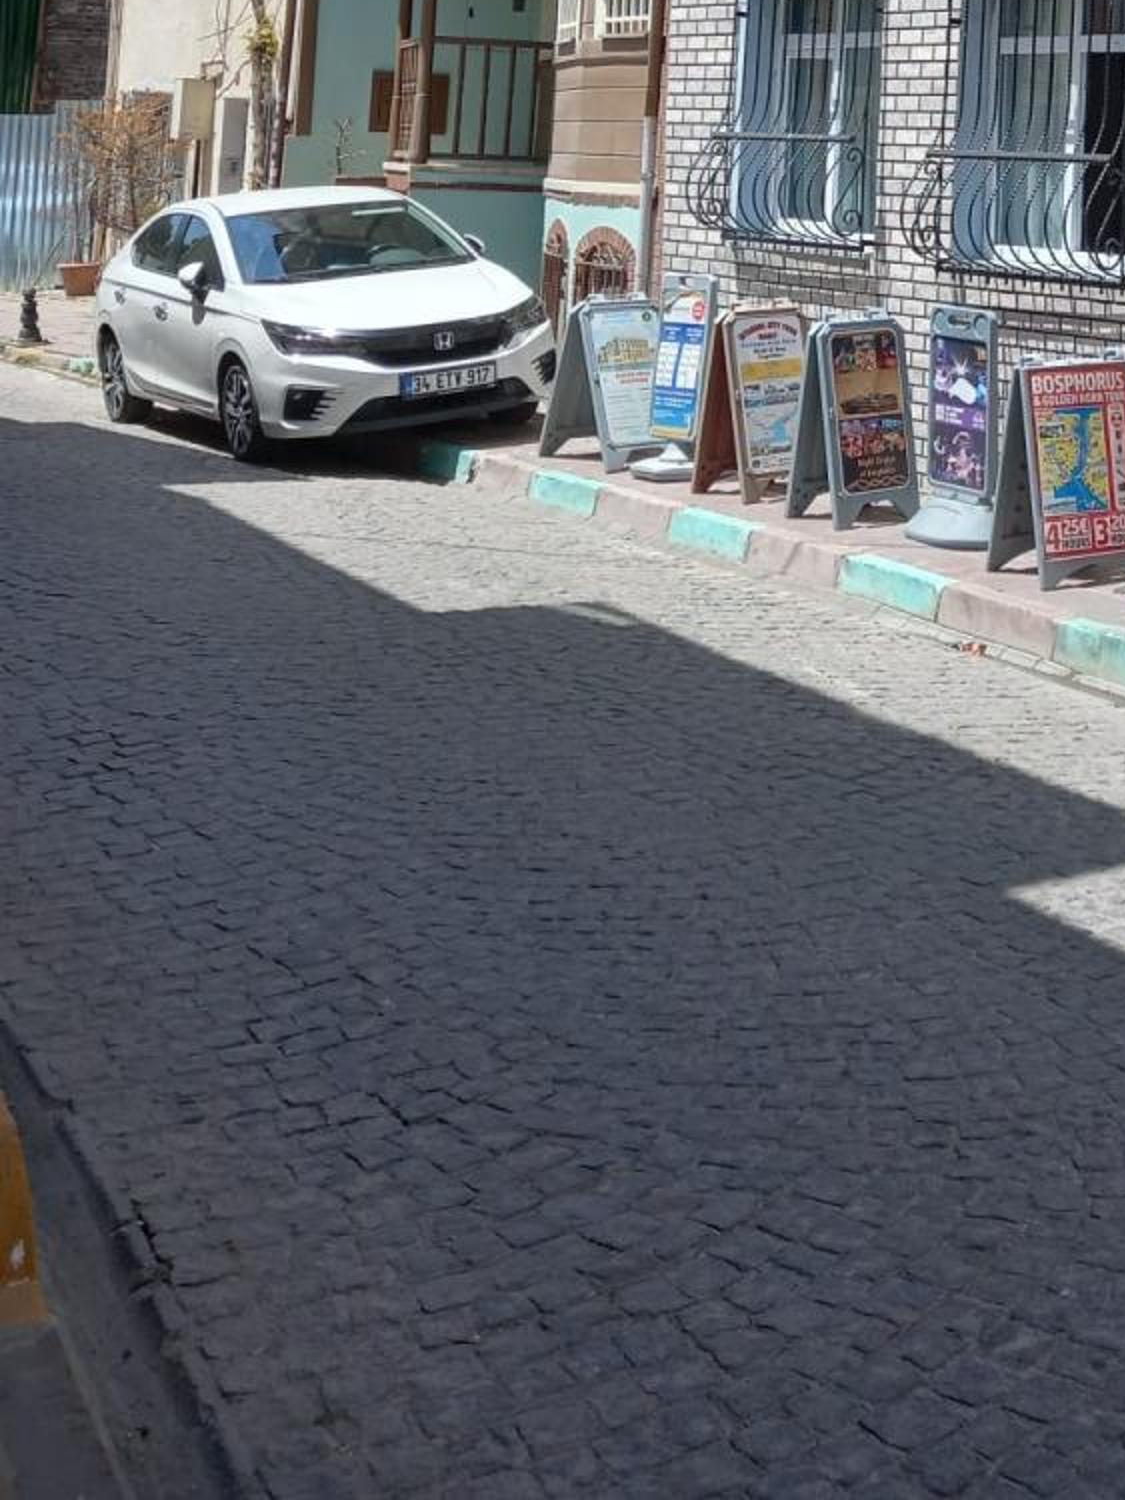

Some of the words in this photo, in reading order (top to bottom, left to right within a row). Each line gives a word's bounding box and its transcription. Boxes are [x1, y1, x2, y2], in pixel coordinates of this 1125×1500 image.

[467, 367, 490, 385] 917
[1031, 371, 1125, 394] BOSPHORUS
[1047, 522, 1060, 552] 4
[1095, 519, 1109, 545] 3
